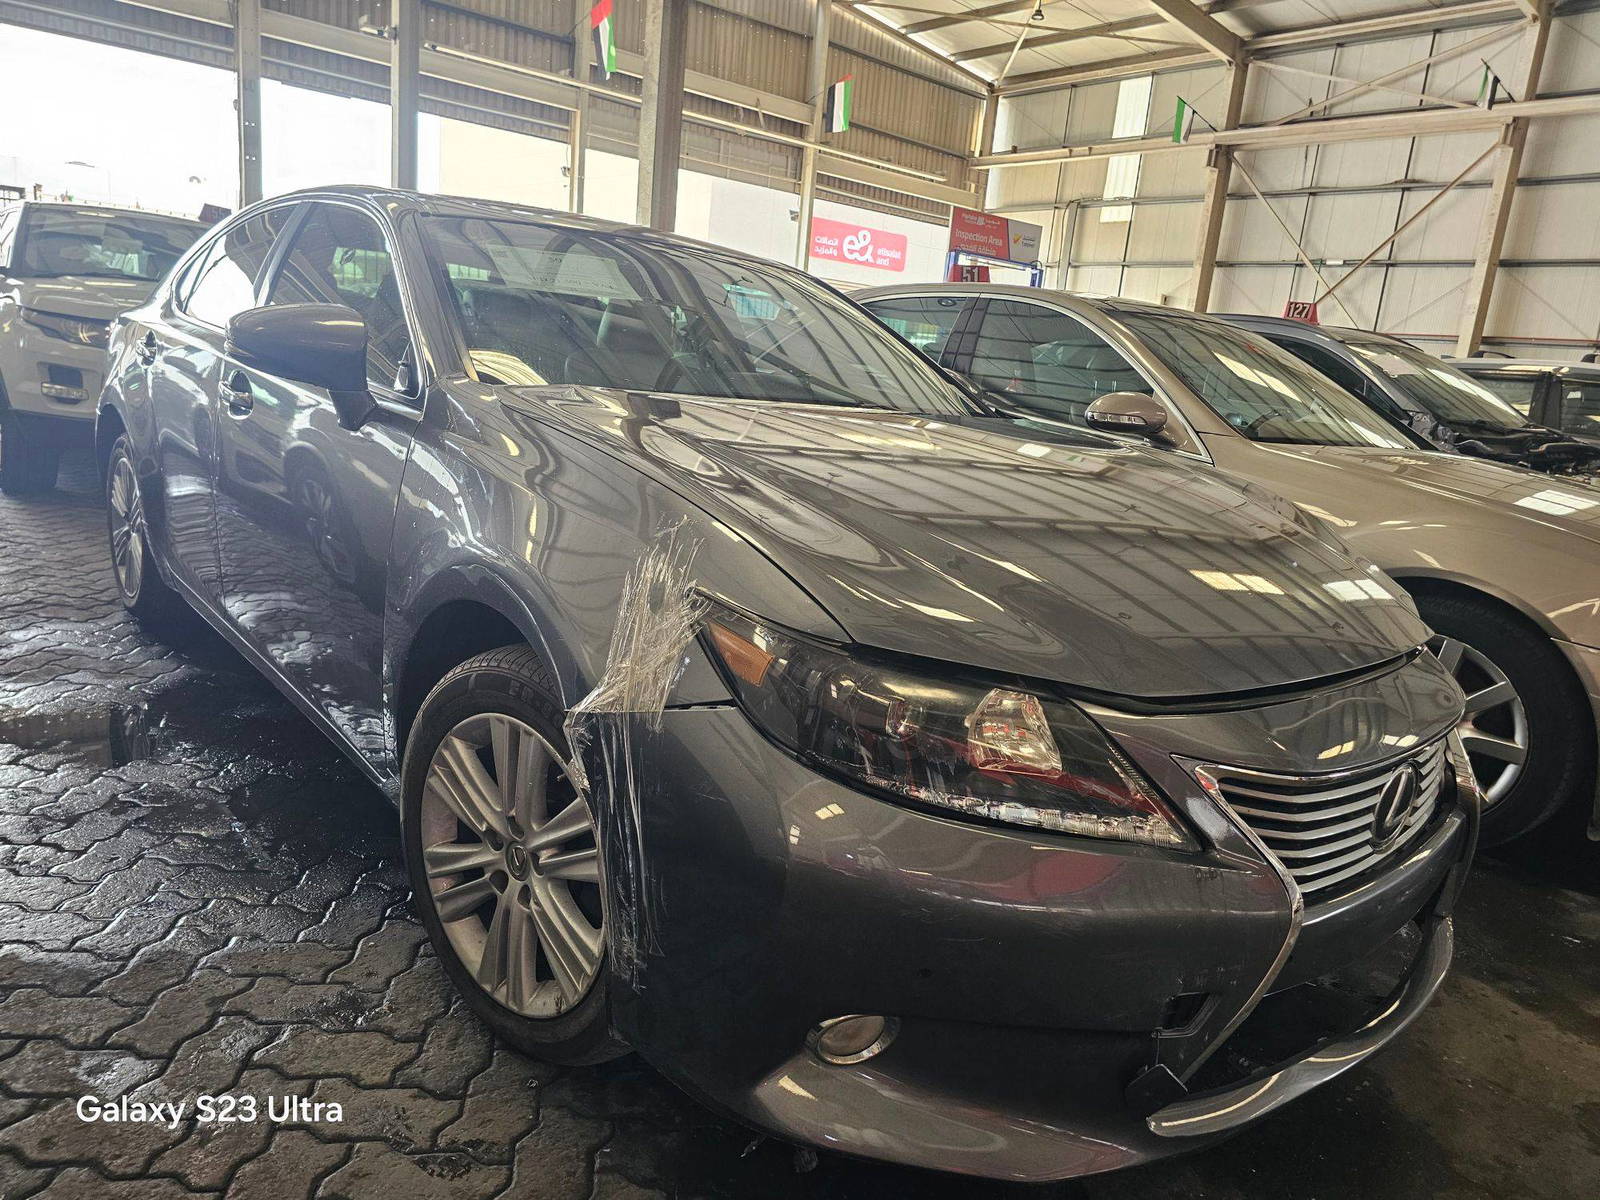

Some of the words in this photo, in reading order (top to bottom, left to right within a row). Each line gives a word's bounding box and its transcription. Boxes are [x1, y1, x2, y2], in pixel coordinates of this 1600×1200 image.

[842, 230, 874, 263] e&
[955, 228, 988, 244] Inspection
[988, 236, 1003, 247] Area
[962, 266, 979, 282] 51
[1288, 302, 1311, 319] 127
